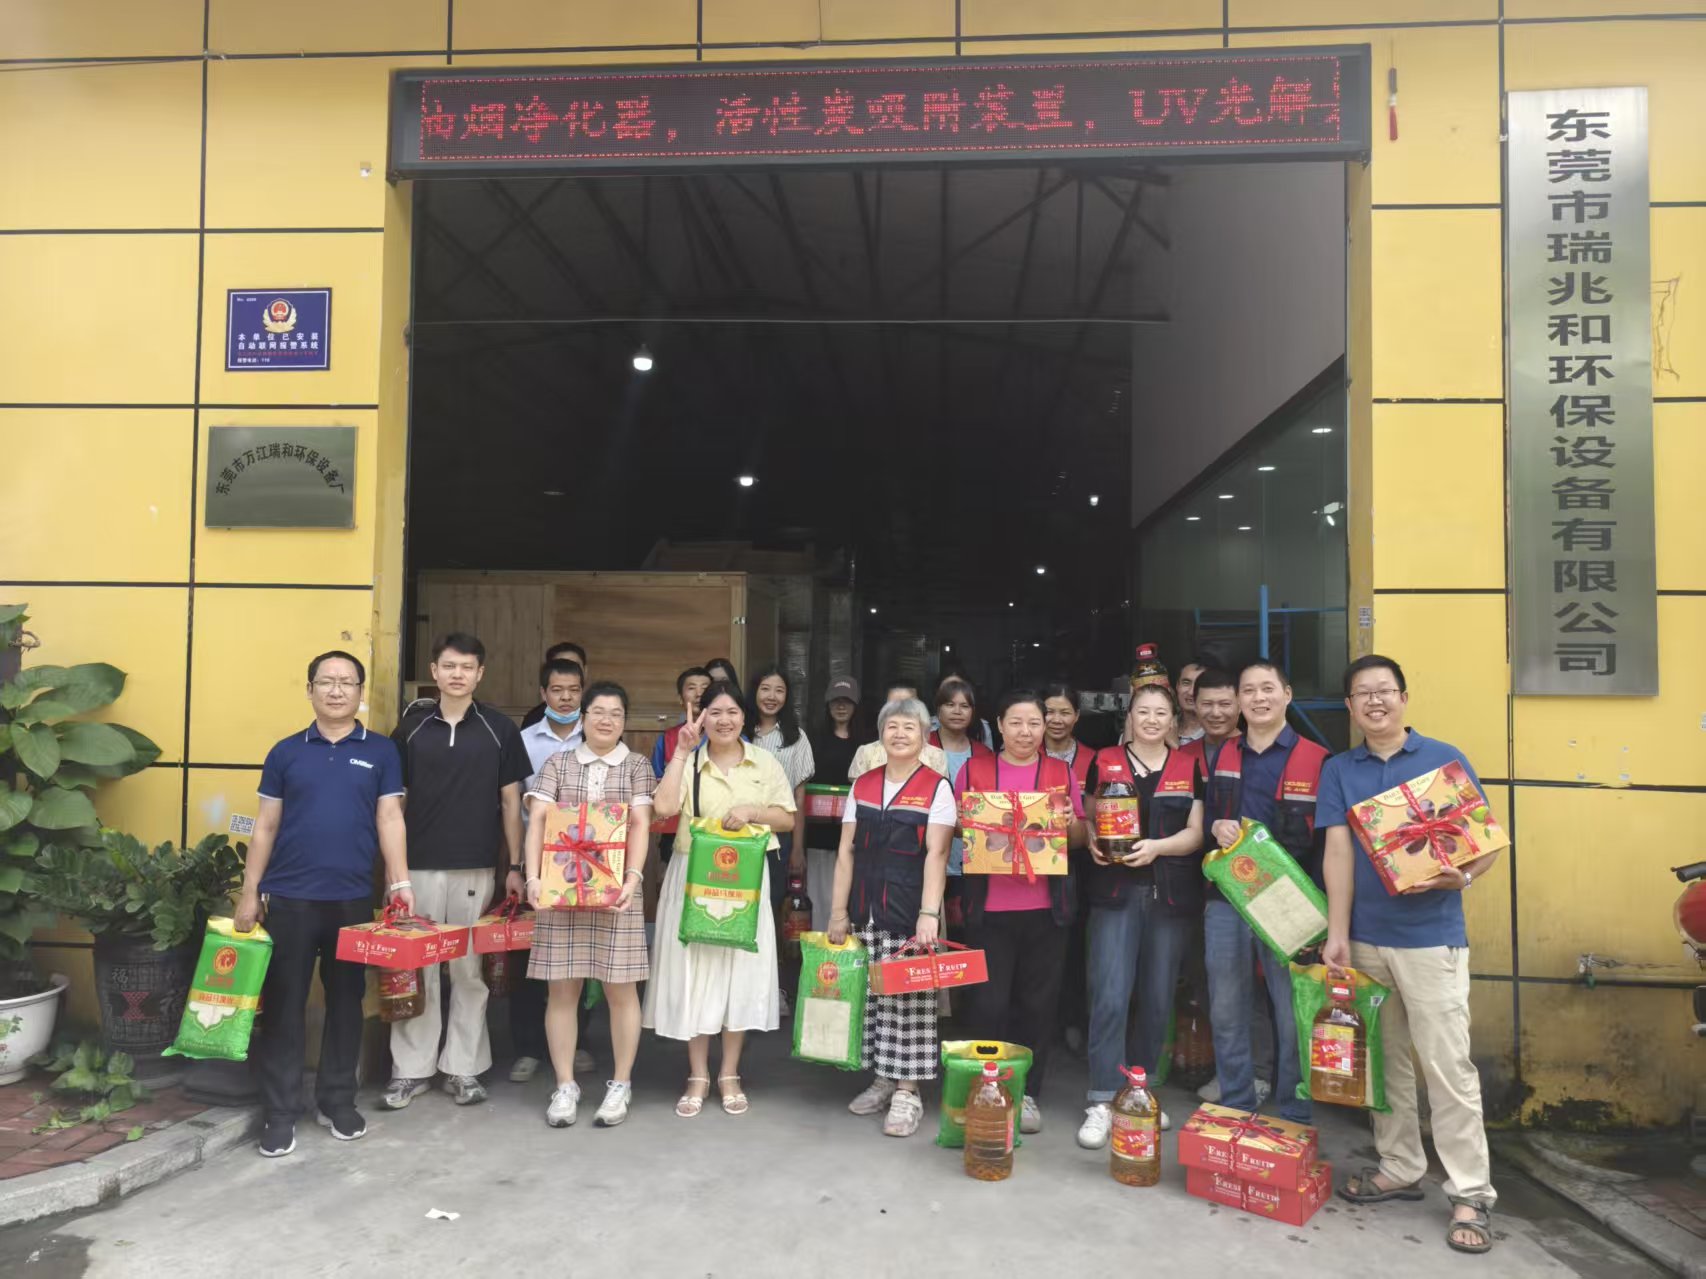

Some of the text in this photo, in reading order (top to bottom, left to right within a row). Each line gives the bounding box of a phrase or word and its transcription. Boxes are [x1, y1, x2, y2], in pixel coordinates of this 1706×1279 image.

[238, 332, 319, 341] 本单位已安装
[238, 341, 319, 350] 自动联网报警系统
[1546, 108, 1619, 676] 东莞市瑞兆和环保设备有限公司
[216, 442, 345, 496] 东莞市万江瑞和环保设备厂
